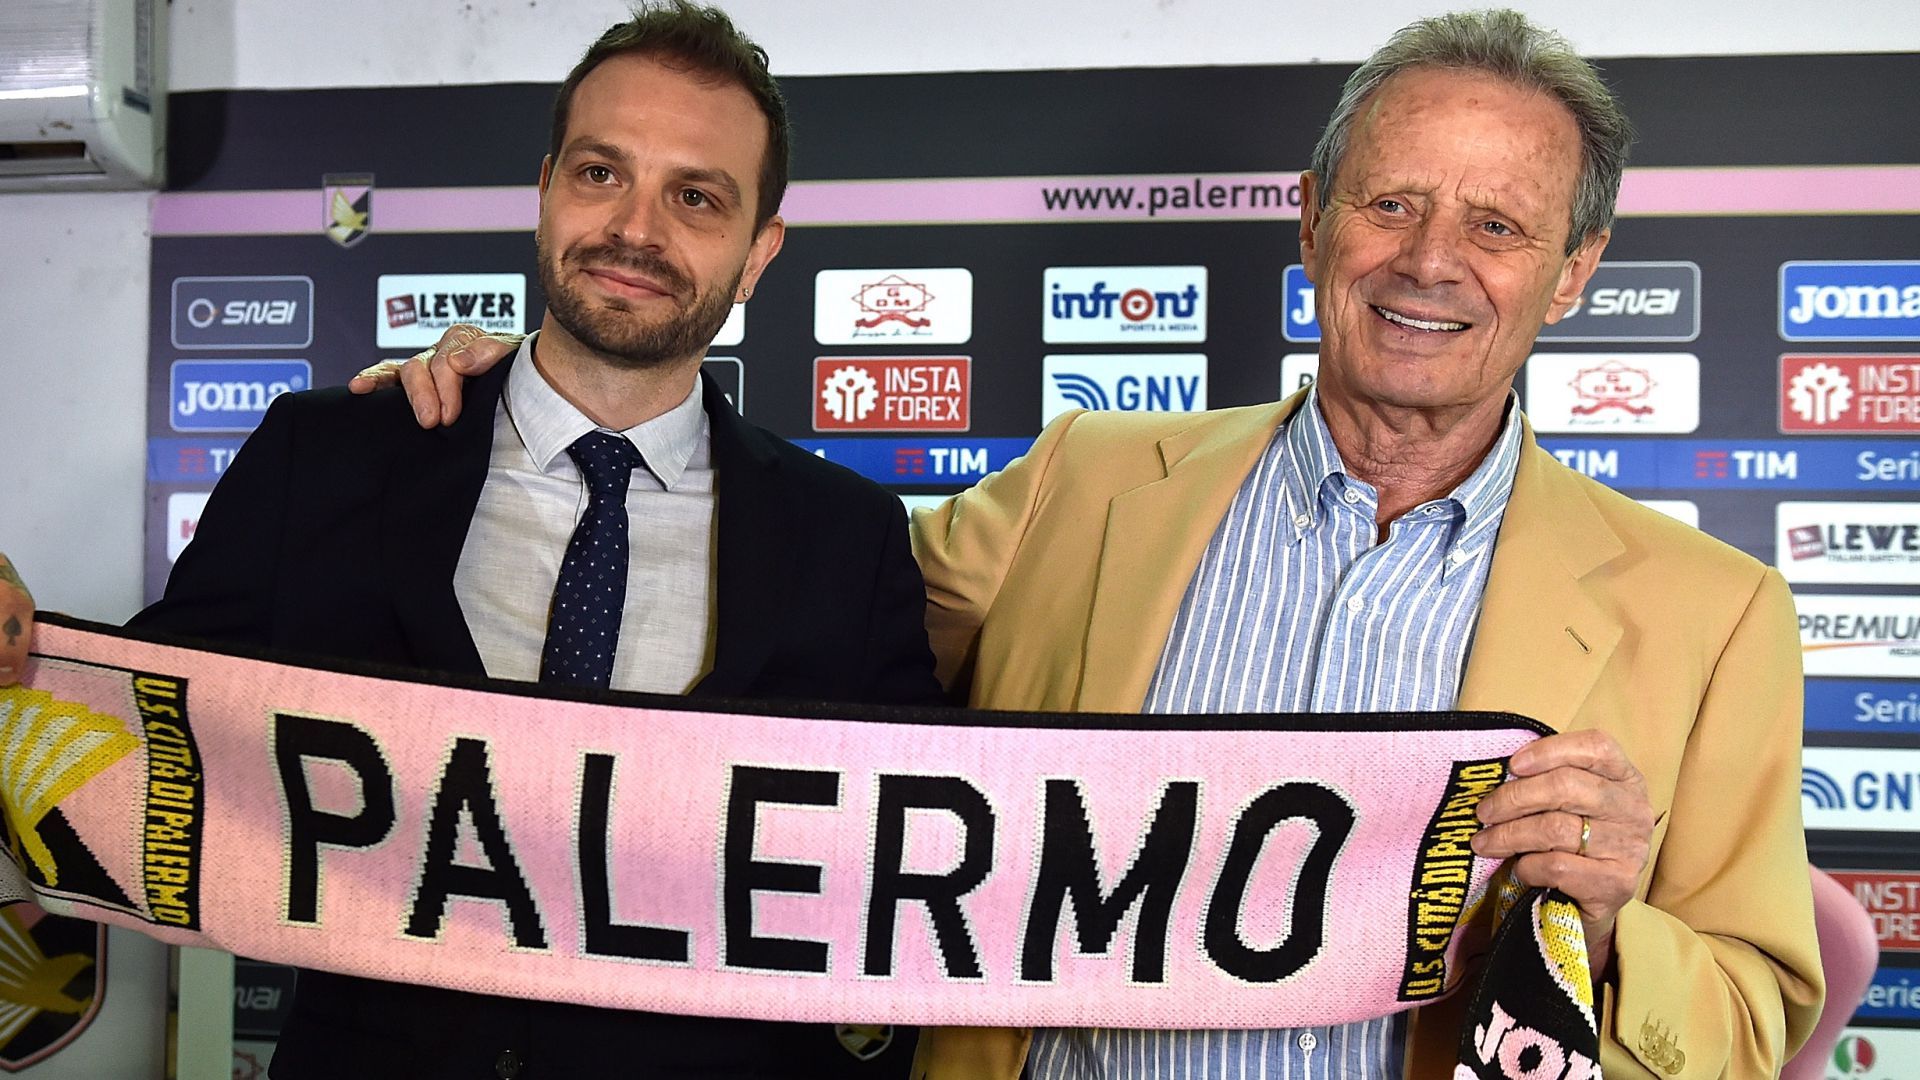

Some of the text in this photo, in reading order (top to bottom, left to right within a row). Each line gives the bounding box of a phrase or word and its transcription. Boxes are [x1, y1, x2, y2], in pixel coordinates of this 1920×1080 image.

[419, 293, 515, 318] LEWER
[884, 367, 962, 393] INSTA
[1117, 375, 1199, 412] GNV
[884, 396, 961, 421] FOREX
[929, 448, 988, 475] TIM
[1554, 449, 1618, 478] TIM
[1732, 451, 1798, 479] TIM
[1855, 692, 1920, 722] Seri
[1854, 772, 1920, 810] GN
[274, 712, 1357, 984] PALERMO
[145, 809, 192, 924] PALERMO
[1872, 912, 1920, 940] ORE
